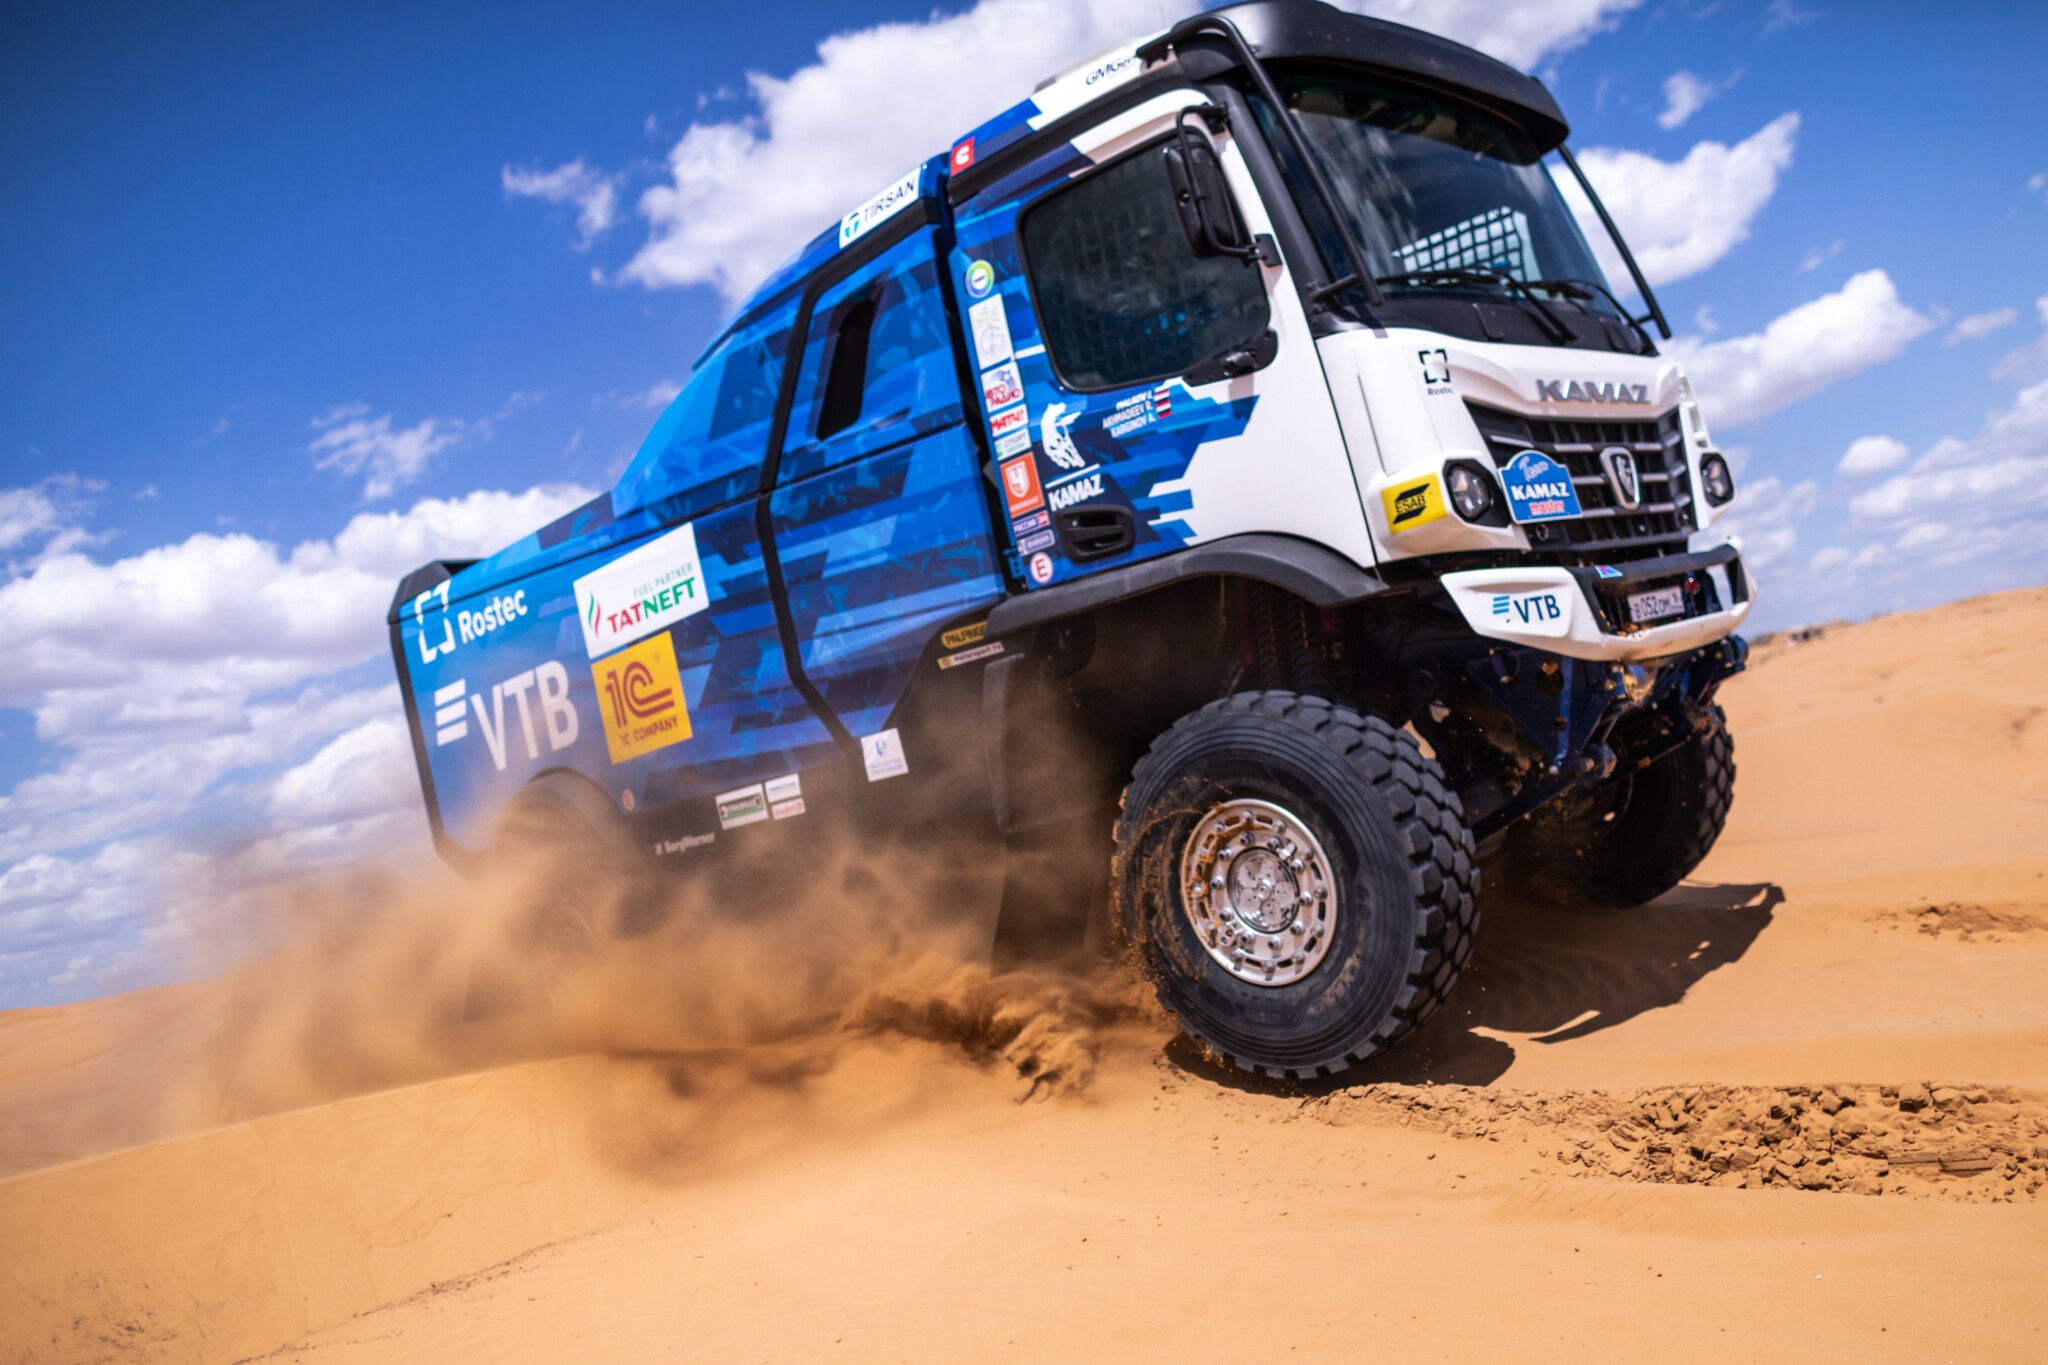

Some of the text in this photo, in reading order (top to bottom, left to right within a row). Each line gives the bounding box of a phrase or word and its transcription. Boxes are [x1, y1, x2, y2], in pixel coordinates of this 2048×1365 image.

[865, 177, 915, 223] TIRSAN
[1536, 379, 1651, 404] KAMAZ
[1048, 474, 1104, 511] KAMAZ
[1395, 494, 1426, 513] ESAB
[1510, 482, 1570, 501] KAMAZ
[654, 562, 693, 591] PARTNER
[1035, 558, 1048, 578] E
[457, 589, 528, 644] Rostec
[607, 576, 696, 634] TATNEFT
[1513, 594, 1561, 623] VTB
[470, 660, 580, 771] VTB
[633, 715, 678, 742] COMPANY
